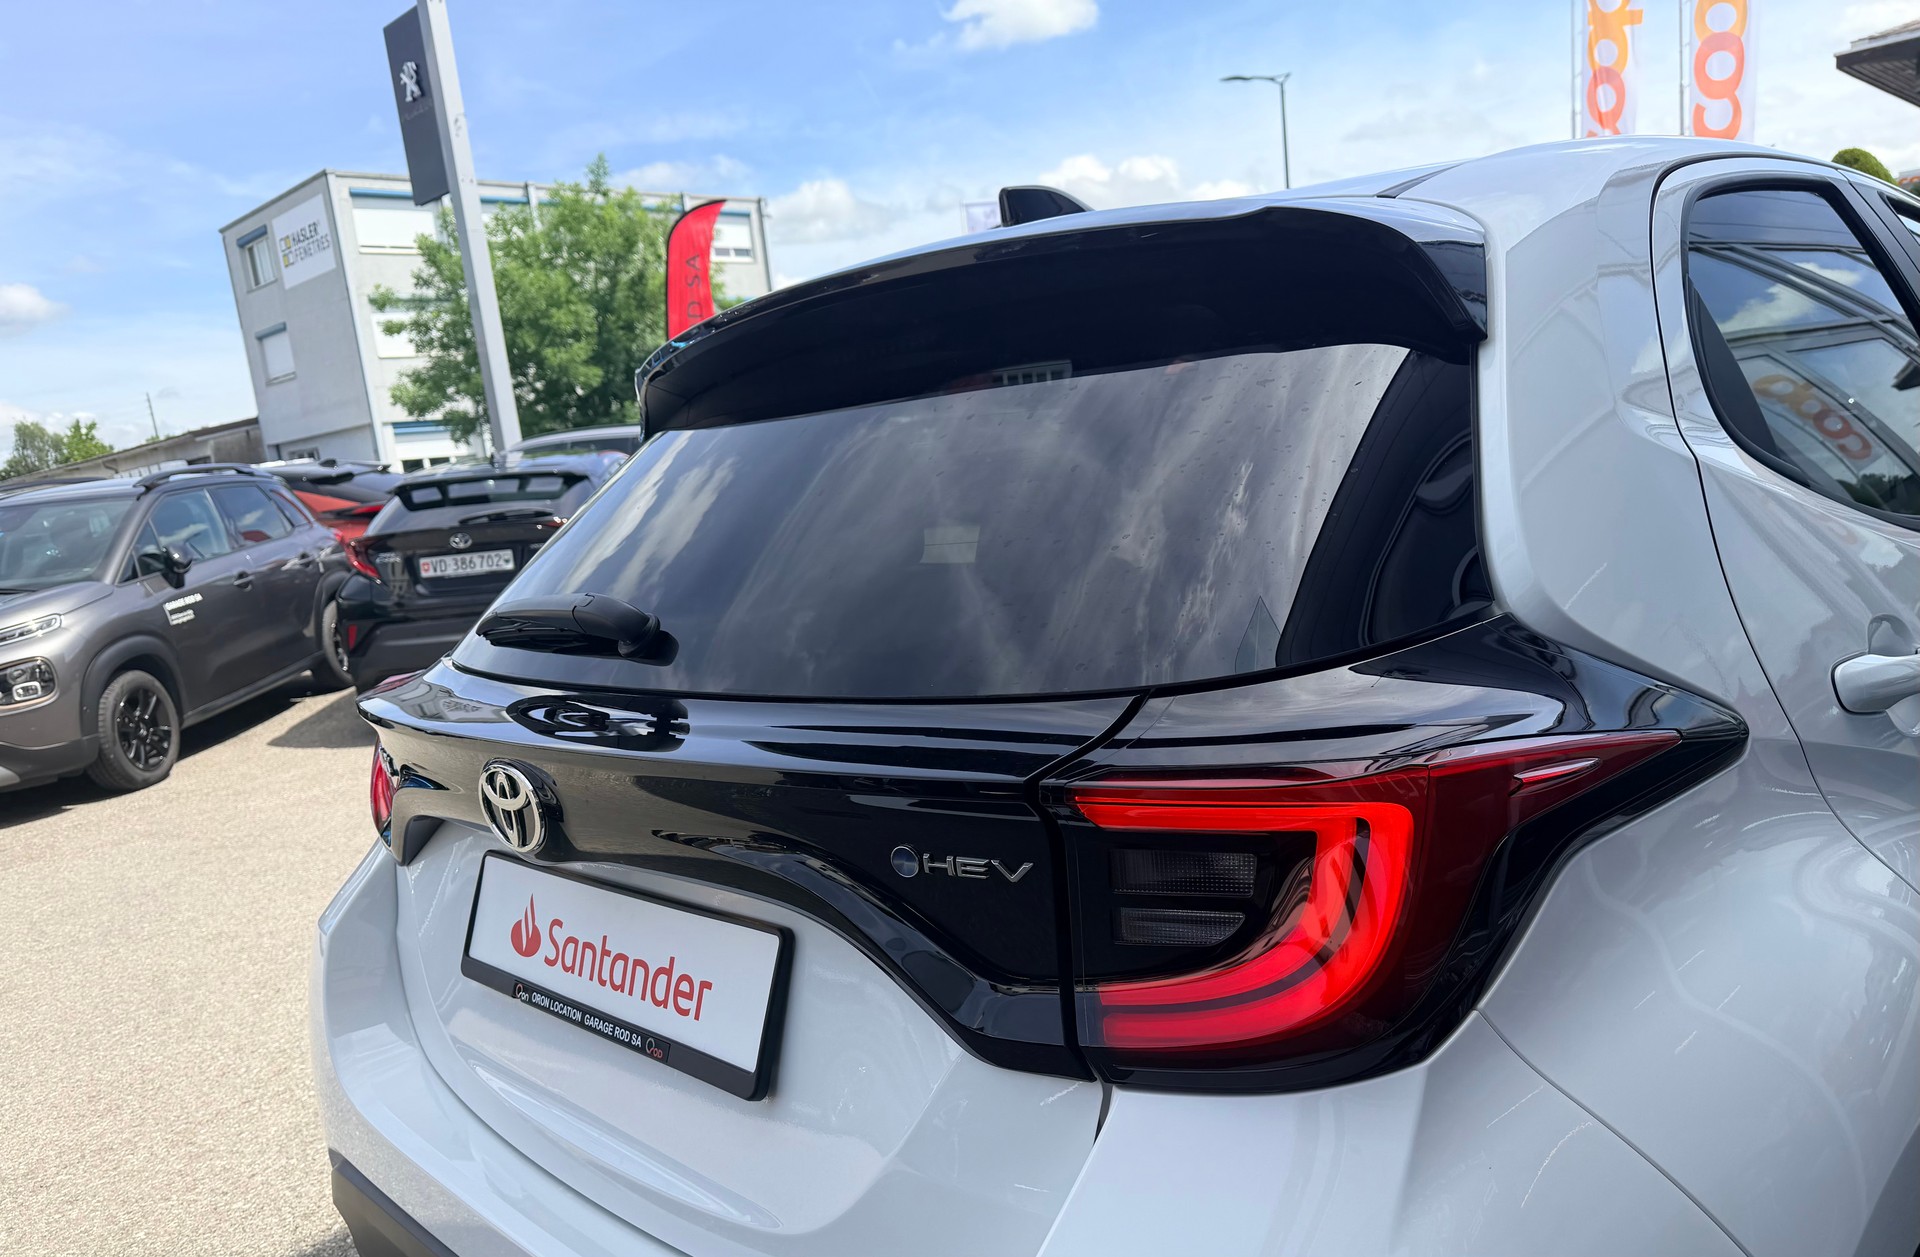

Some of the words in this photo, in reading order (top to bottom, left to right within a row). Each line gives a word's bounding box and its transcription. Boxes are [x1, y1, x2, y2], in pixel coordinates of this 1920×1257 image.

[291, 222, 319, 247] HASLER
[685, 254, 702, 288] SA
[430, 559, 448, 574] VD
[922, 852, 1034, 883] HEV
[543, 918, 713, 1021] Santander
[531, 991, 551, 1009] ORON
[549, 999, 583, 1023] LOCATION
[583, 1014, 614, 1037] GARAGE
[613, 1025, 631, 1043] ROD
[630, 1033, 642, 1048] SA
